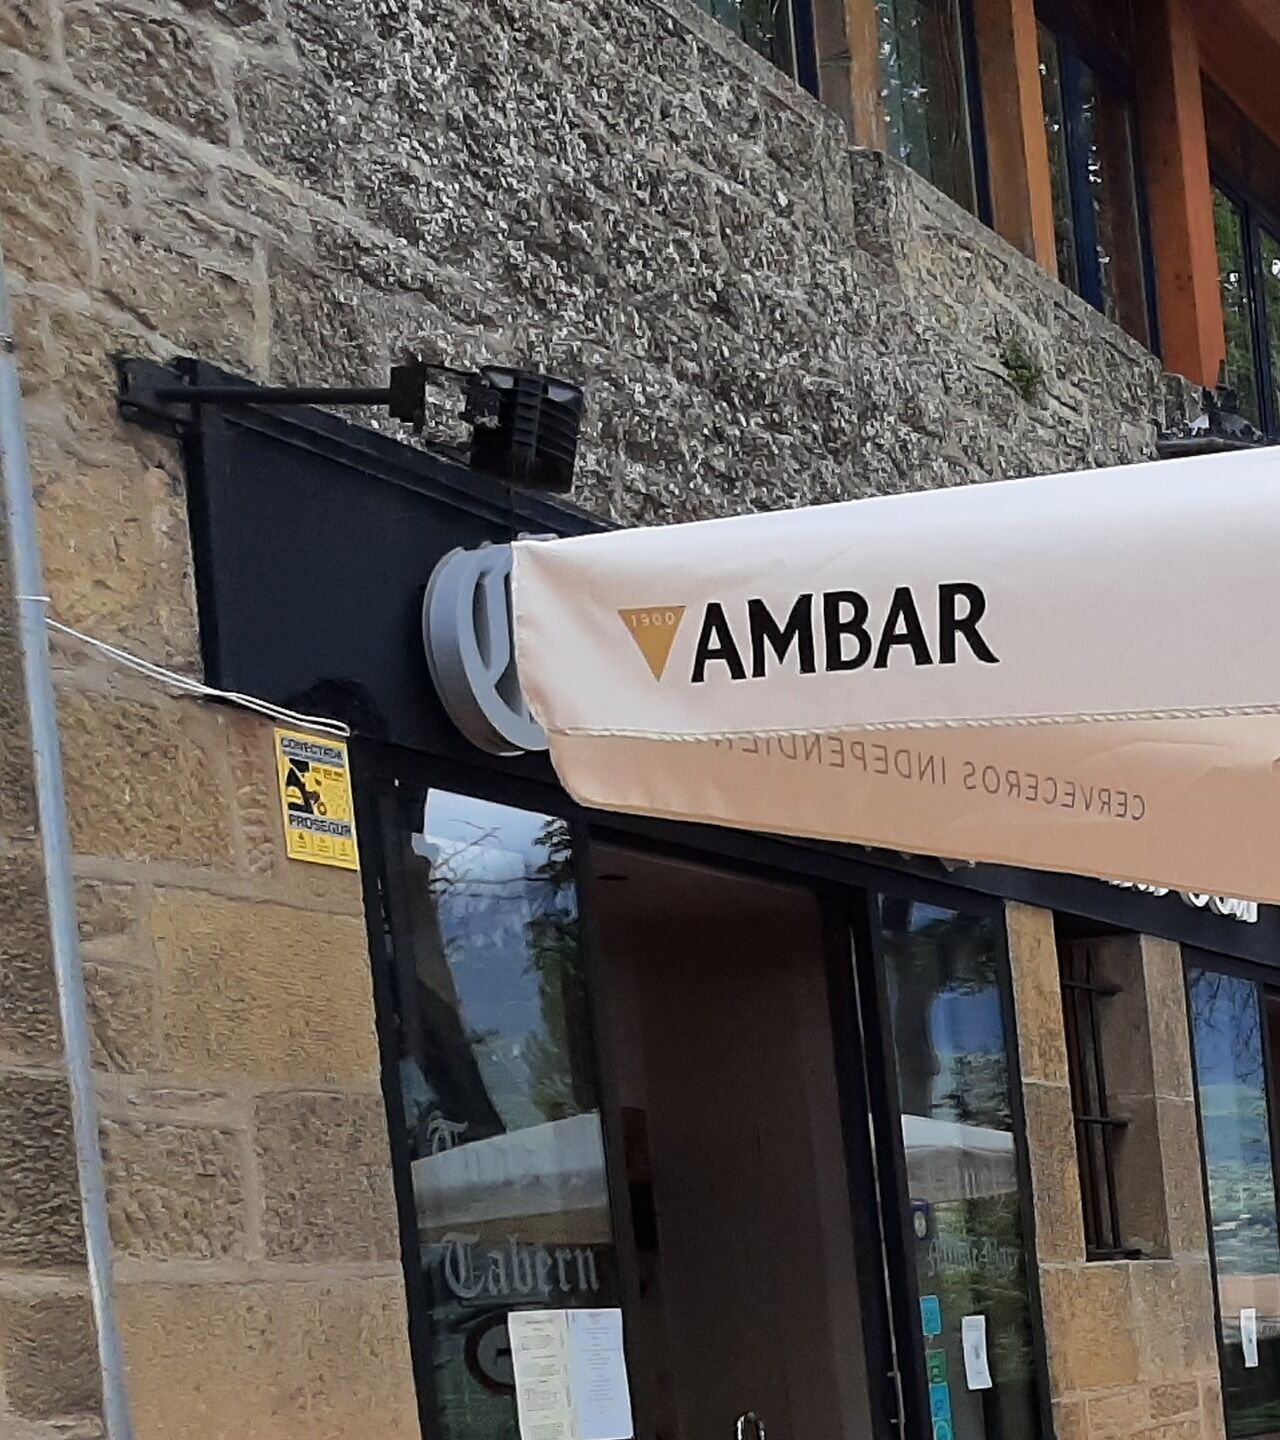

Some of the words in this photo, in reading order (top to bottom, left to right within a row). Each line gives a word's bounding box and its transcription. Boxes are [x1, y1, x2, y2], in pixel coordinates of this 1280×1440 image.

[631, 611, 675, 628] 1900
[690, 581, 1001, 683] AMBAR
[289, 813, 351, 836] PROSEGUR
